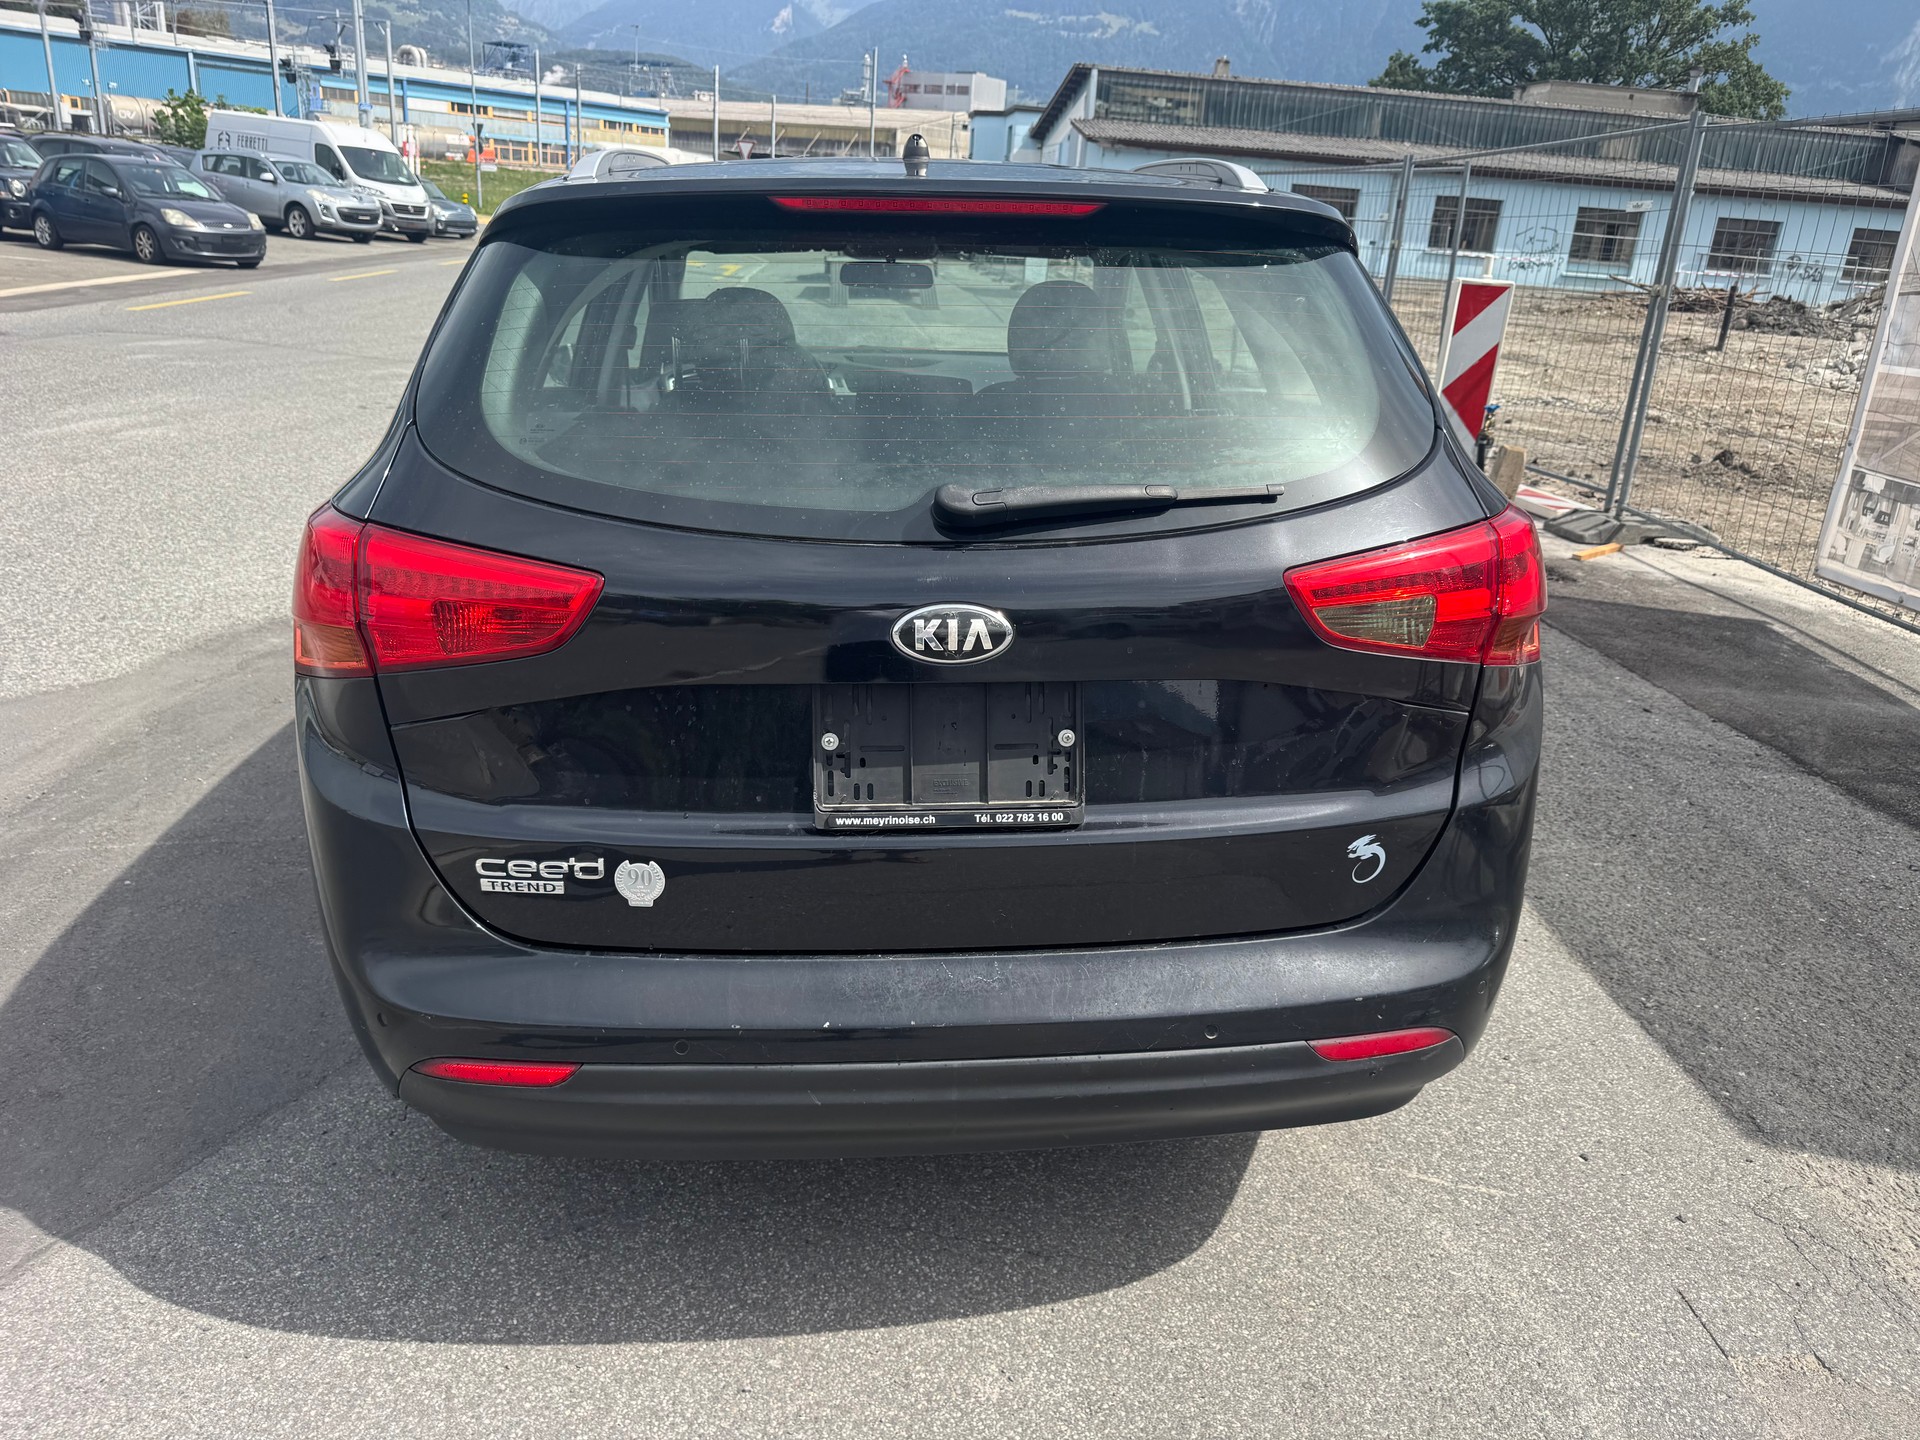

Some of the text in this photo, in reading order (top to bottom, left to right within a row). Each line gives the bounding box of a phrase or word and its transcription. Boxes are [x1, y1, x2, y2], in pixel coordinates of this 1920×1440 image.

[237, 134, 268, 151] FERRETTI
[913, 618, 994, 651] KIA
[835, 814, 936, 827] www.meyrinoise.ch
[974, 812, 1064, 823] Tél. 022 782 16 00
[627, 867, 653, 886] 90
[487, 880, 557, 893] TREND
